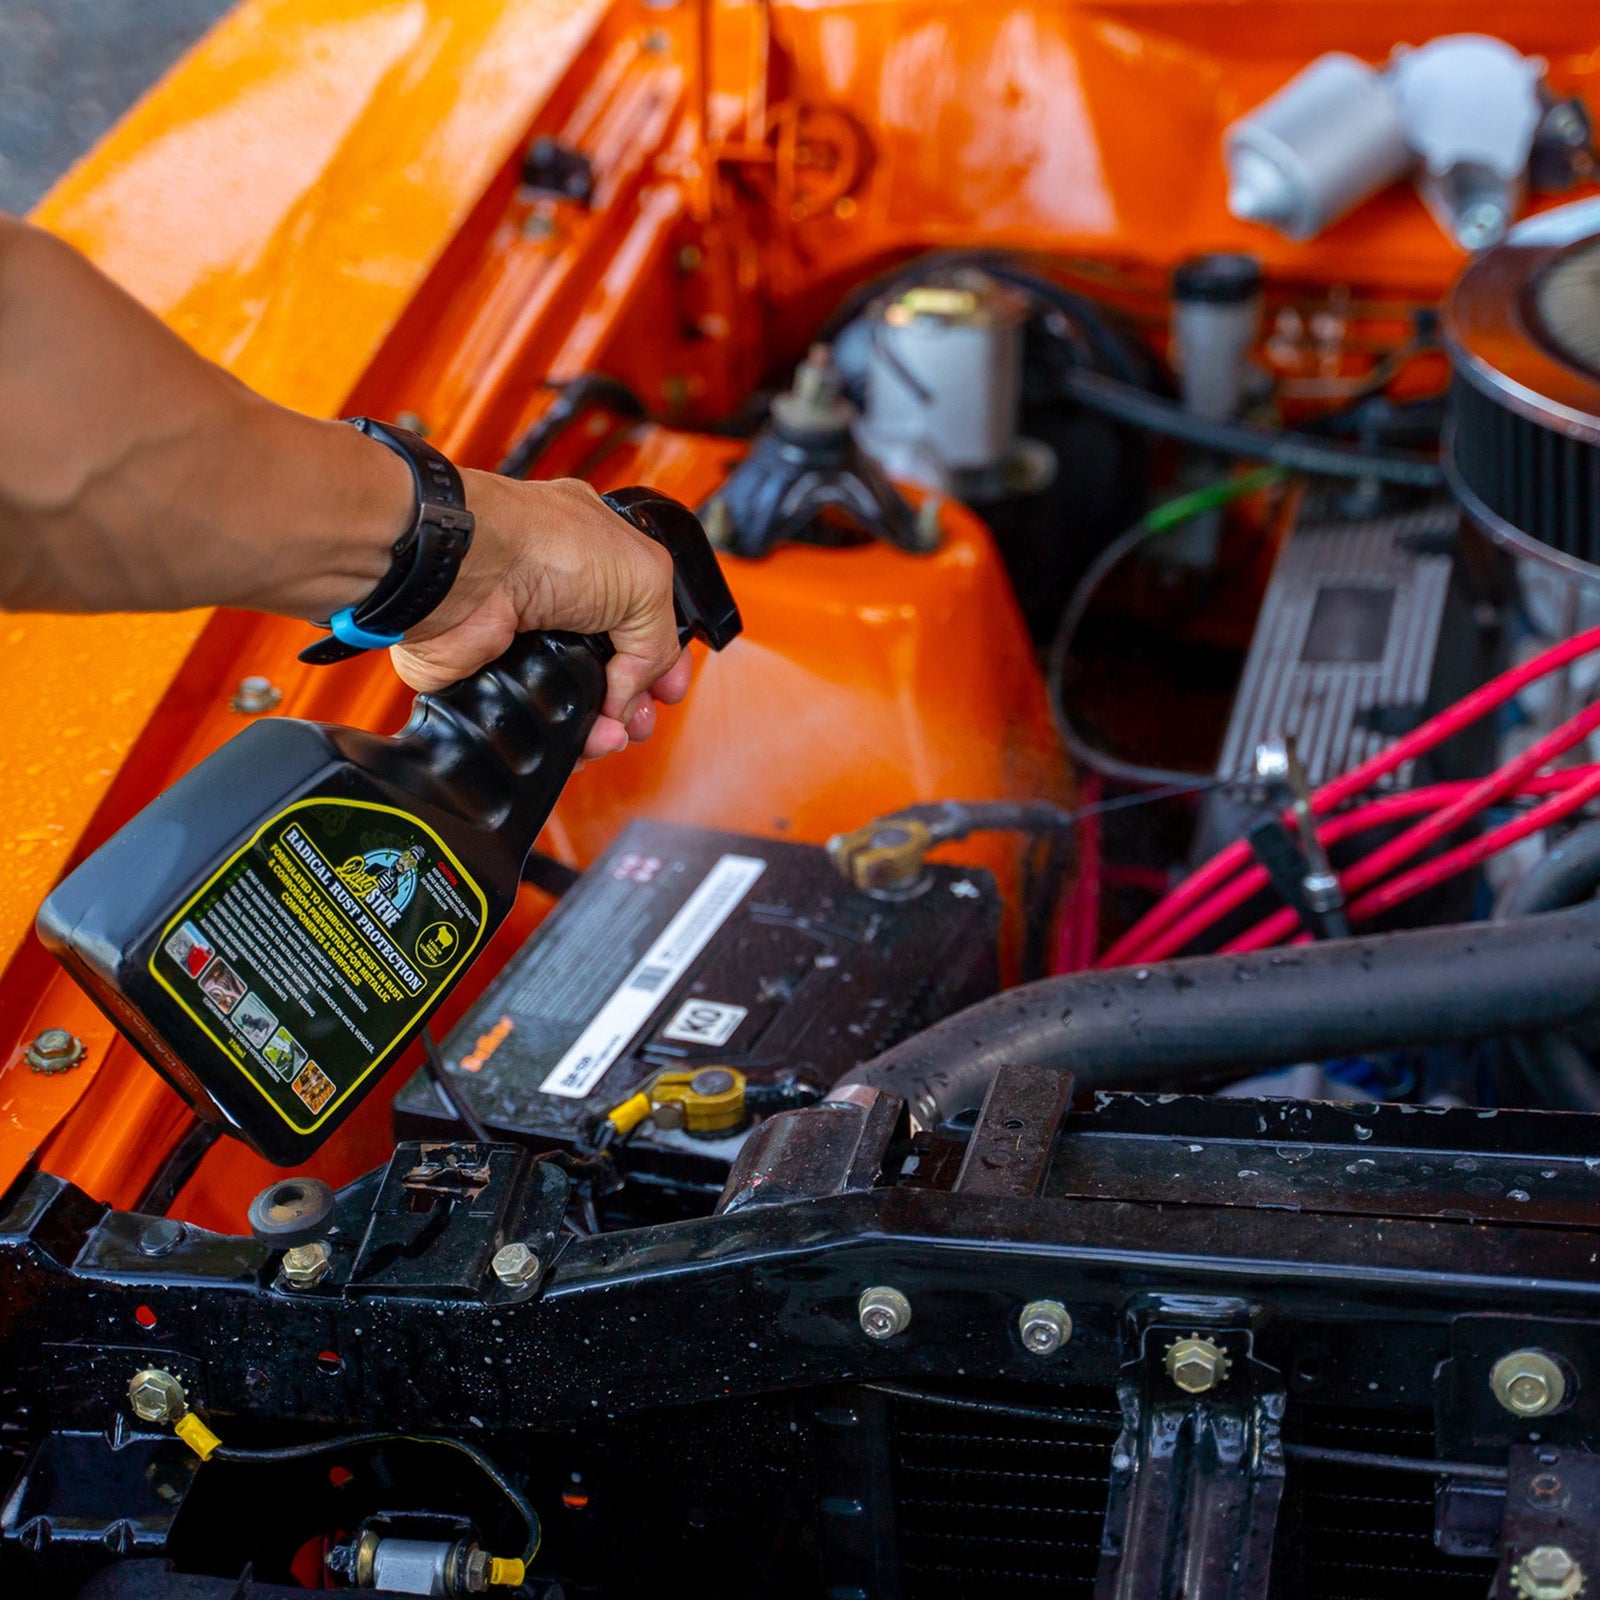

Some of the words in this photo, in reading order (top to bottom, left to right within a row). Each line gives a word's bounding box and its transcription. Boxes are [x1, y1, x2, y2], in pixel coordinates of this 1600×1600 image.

[250, 892, 273, 918] RESISTANT
[269, 915, 279, 925] TO
[299, 950, 312, 964] ACID
[268, 842, 313, 894] FORMULATED
[308, 889, 322, 905] TO
[317, 901, 355, 943] LUBRICATE
[355, 945, 380, 974] ASSIST
[375, 970, 388, 983] IN
[383, 979, 404, 1002] RUST
[279, 890, 326, 944] COMPONENTS
[284, 827, 335, 885] RADICAL
[327, 880, 362, 918] RUST
[354, 913, 423, 991] PROTECTION
[334, 856, 380, 899] Dirty
[364, 888, 402, 928] STEVE
[236, 926, 256, 948] MOVING
[270, 966, 284, 980] HELP
[280, 978, 301, 1000] PREVENT
[240, 897, 252, 910] FOR
[248, 906, 277, 938] APPLICATION
[278, 941, 300, 966] METALLIC
[296, 962, 319, 988] EXTERNAL
[314, 984, 338, 1009] SURFACES
[334, 1006, 344, 1017] ON
[244, 868, 260, 886] SPRAY
[256, 883, 267, 893] ON
[291, 924, 311, 946] LANOLIN
[307, 943, 332, 970] LUBRICANT
[331, 971, 345, 985] RUST
[341, 982, 368, 1013] PREVENTION
[266, 858, 276, 868] &
[271, 863, 312, 909] CORROSION
[307, 906, 350, 954] PREVENTION
[344, 950, 362, 970] FOR
[357, 965, 391, 1004] METALLIC
[322, 940, 332, 950] &
[326, 946, 363, 986] SURFACES
[269, 948, 293, 975] OUTBOARD
[290, 972, 310, 994] MOTORS
